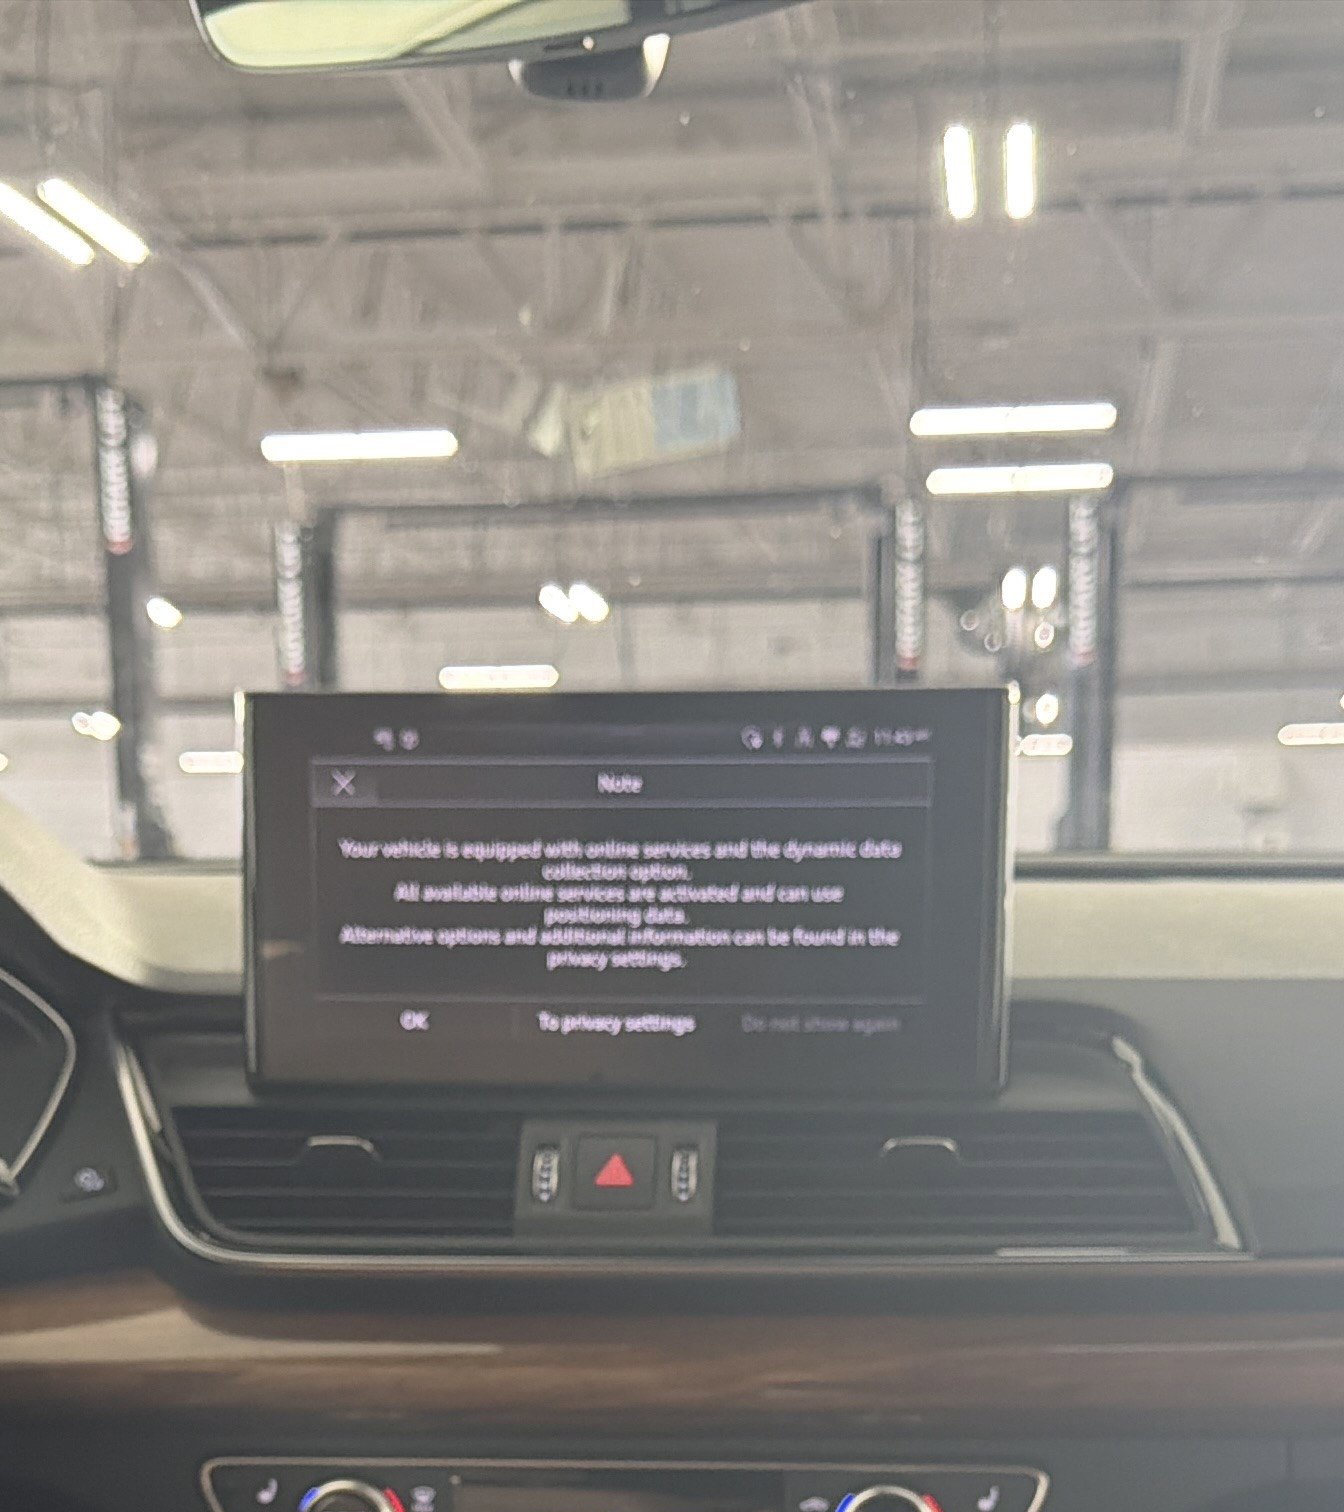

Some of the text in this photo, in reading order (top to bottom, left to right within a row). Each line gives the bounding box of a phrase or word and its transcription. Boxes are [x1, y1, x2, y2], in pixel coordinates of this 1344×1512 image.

[597, 773, 644, 794] Note
[338, 838, 902, 863] Your vehicle is equipped with online services and the dynamic data
[542, 861, 692, 883] collection option.
[393, 880, 844, 903] All available online services are activated and can use
[544, 906, 690, 927] positioning data.
[339, 924, 901, 949] Alternative options and additional information can be found in the
[546, 950, 687, 972] privacy settings.
[399, 1009, 430, 1031] OK
[537, 1010, 697, 1036] To privacy settings
